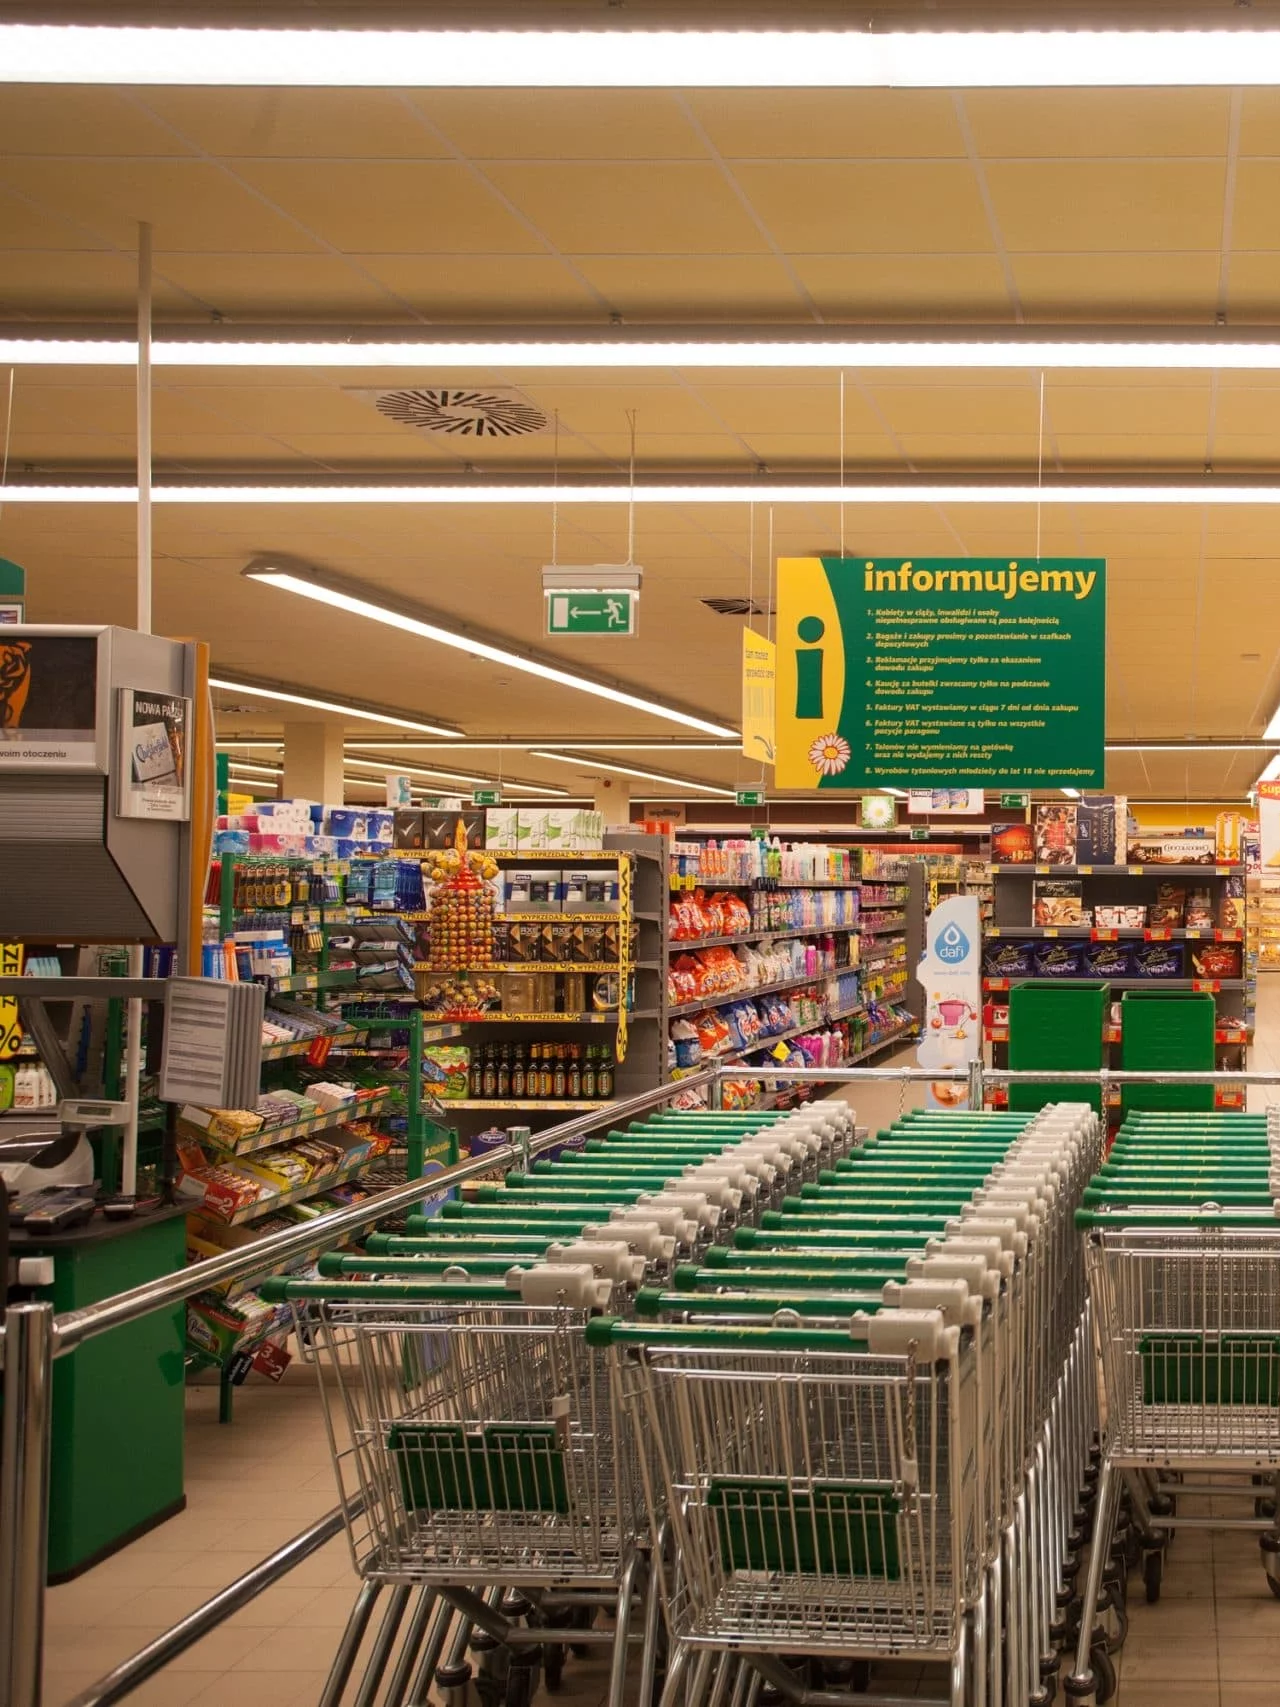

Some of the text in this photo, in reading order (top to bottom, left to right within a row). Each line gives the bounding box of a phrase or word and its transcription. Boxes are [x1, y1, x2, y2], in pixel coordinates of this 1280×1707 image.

[864, 562, 1096, 599] informujemy
[135, 701, 160, 716] NOWA
[22, 749, 66, 758] otoczeniu
[940, 945, 965, 958] dafi
[261, 1346, 274, 1359] 3
[271, 1365, 284, 1379] 2
